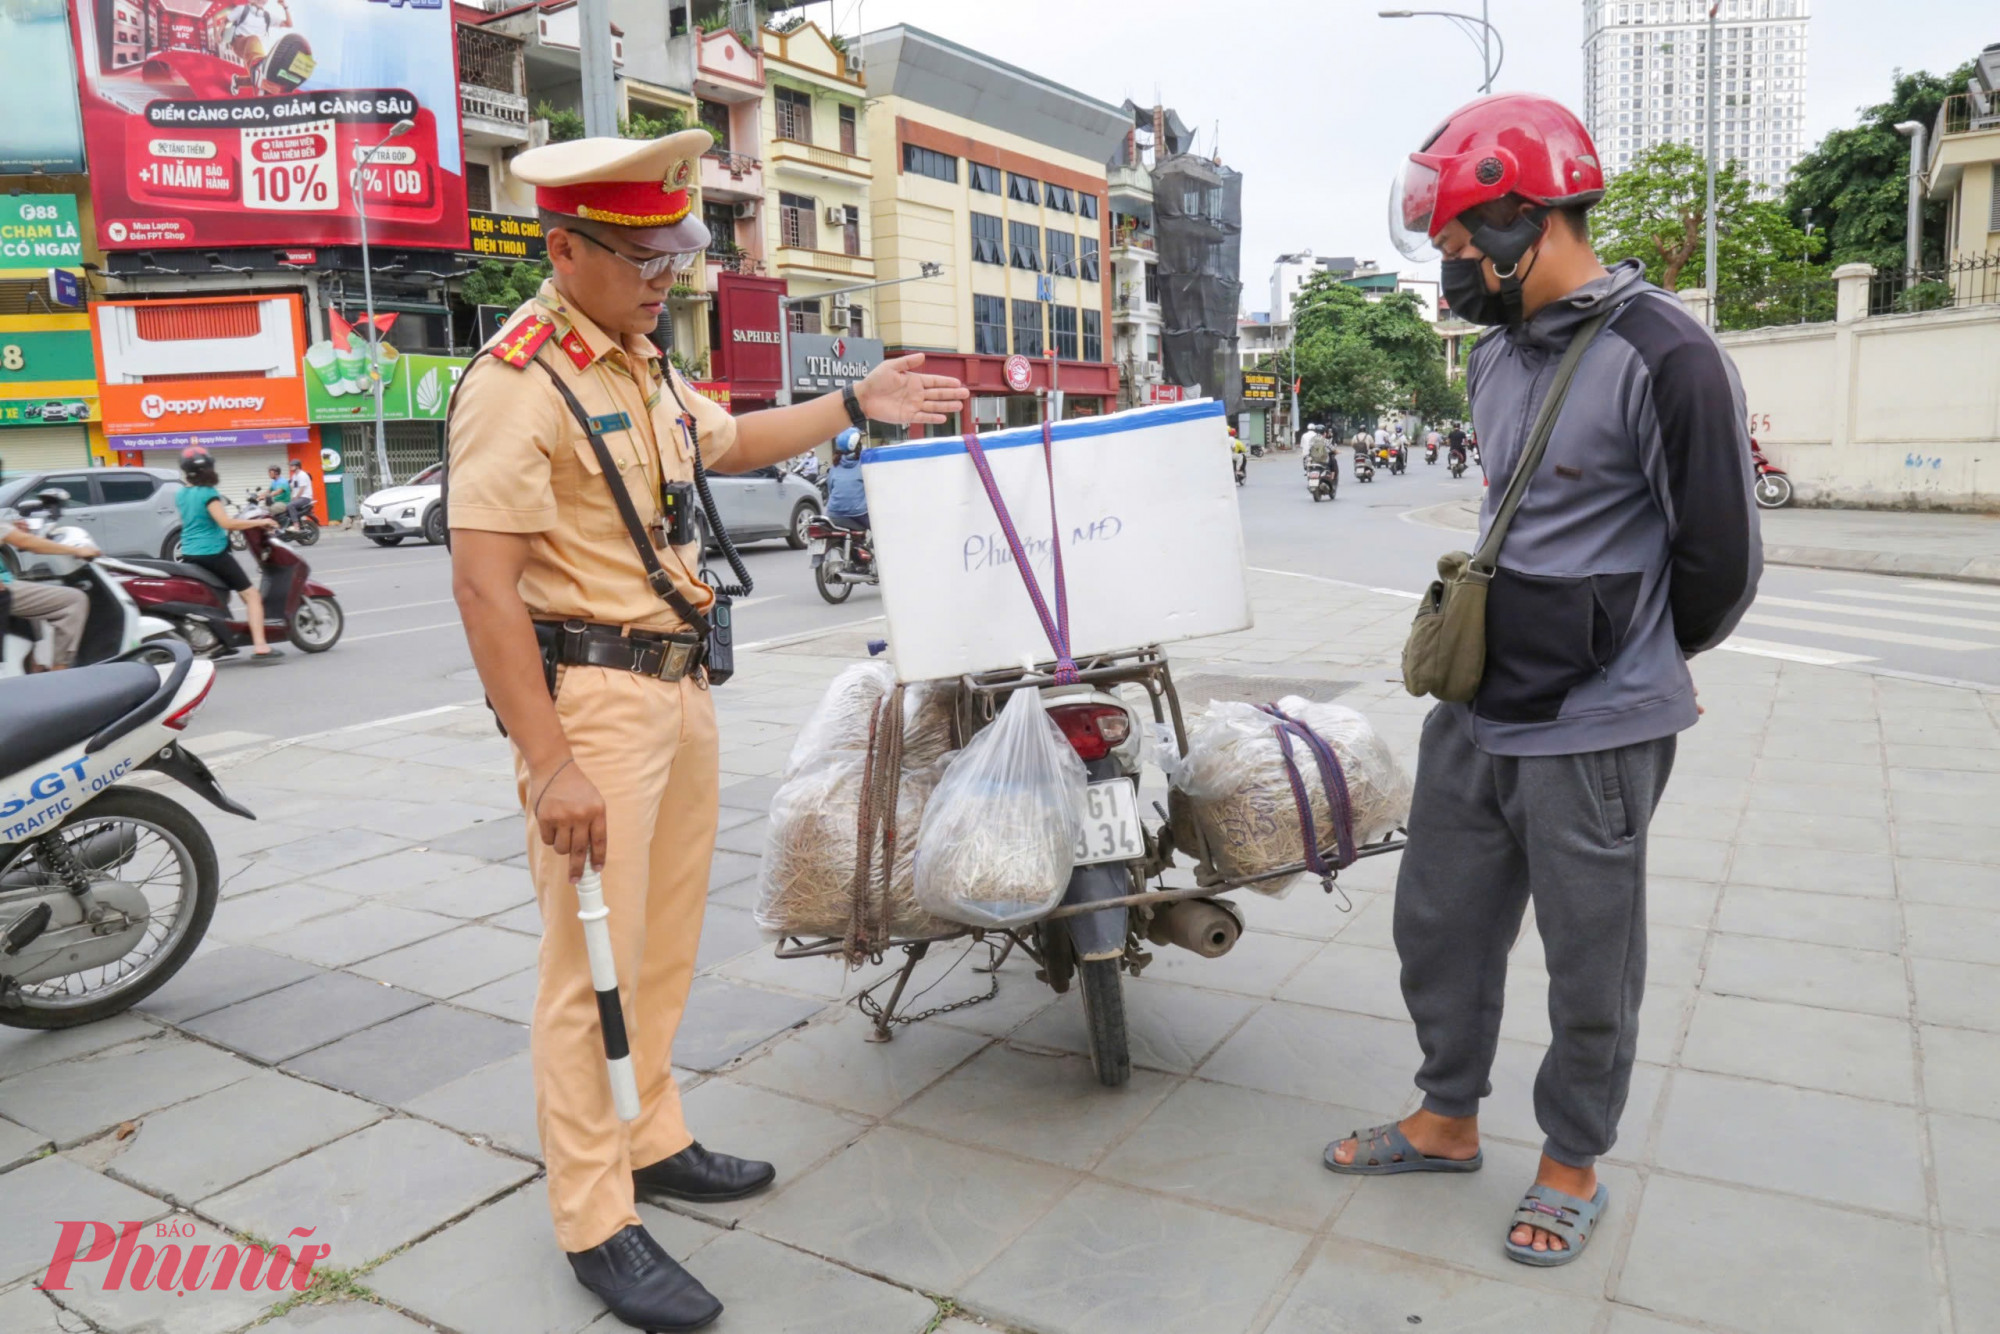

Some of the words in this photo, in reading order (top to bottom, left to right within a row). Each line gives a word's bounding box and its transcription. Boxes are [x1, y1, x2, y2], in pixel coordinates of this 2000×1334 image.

[151, 104, 185, 120] ĐIỂM
[188, 106, 228, 121] CÀNG
[231, 106, 269, 121] CAO,
[273, 99, 316, 117] GIẢM
[319, 97, 372, 114] CÀNG
[376, 97, 412, 114] SÂU
[162, 160, 202, 188] NĂM
[252, 164, 327, 202] 10%
[20, 204, 58, 221] F88
[1, 225, 52, 242] CHẠM
[56, 221, 77, 238] LÀ
[132, 222, 150, 231] Mua
[152, 222, 179, 232] Laptop
[147, 232, 162, 240] FPT
[164, 231, 185, 241] Shop
[470, 215, 493, 235] KIỆN
[500, 216, 520, 235] SỬA
[521, 221, 543, 237] CHỮ
[4, 240, 30, 256] CÓ
[34, 243, 81, 256] NGAY
[288, 252, 312, 260] smart
[473, 236, 496, 256] ĐIỆN
[497, 240, 526, 258] THOẠI
[733, 329, 780, 343] SAPHIRE
[0, 344, 24, 370] 8
[141, 394, 206, 418] Happy
[209, 396, 265, 411] Money
[81, 757, 132, 792] OLICE
[2, 797, 73, 840] TRAFFIC
